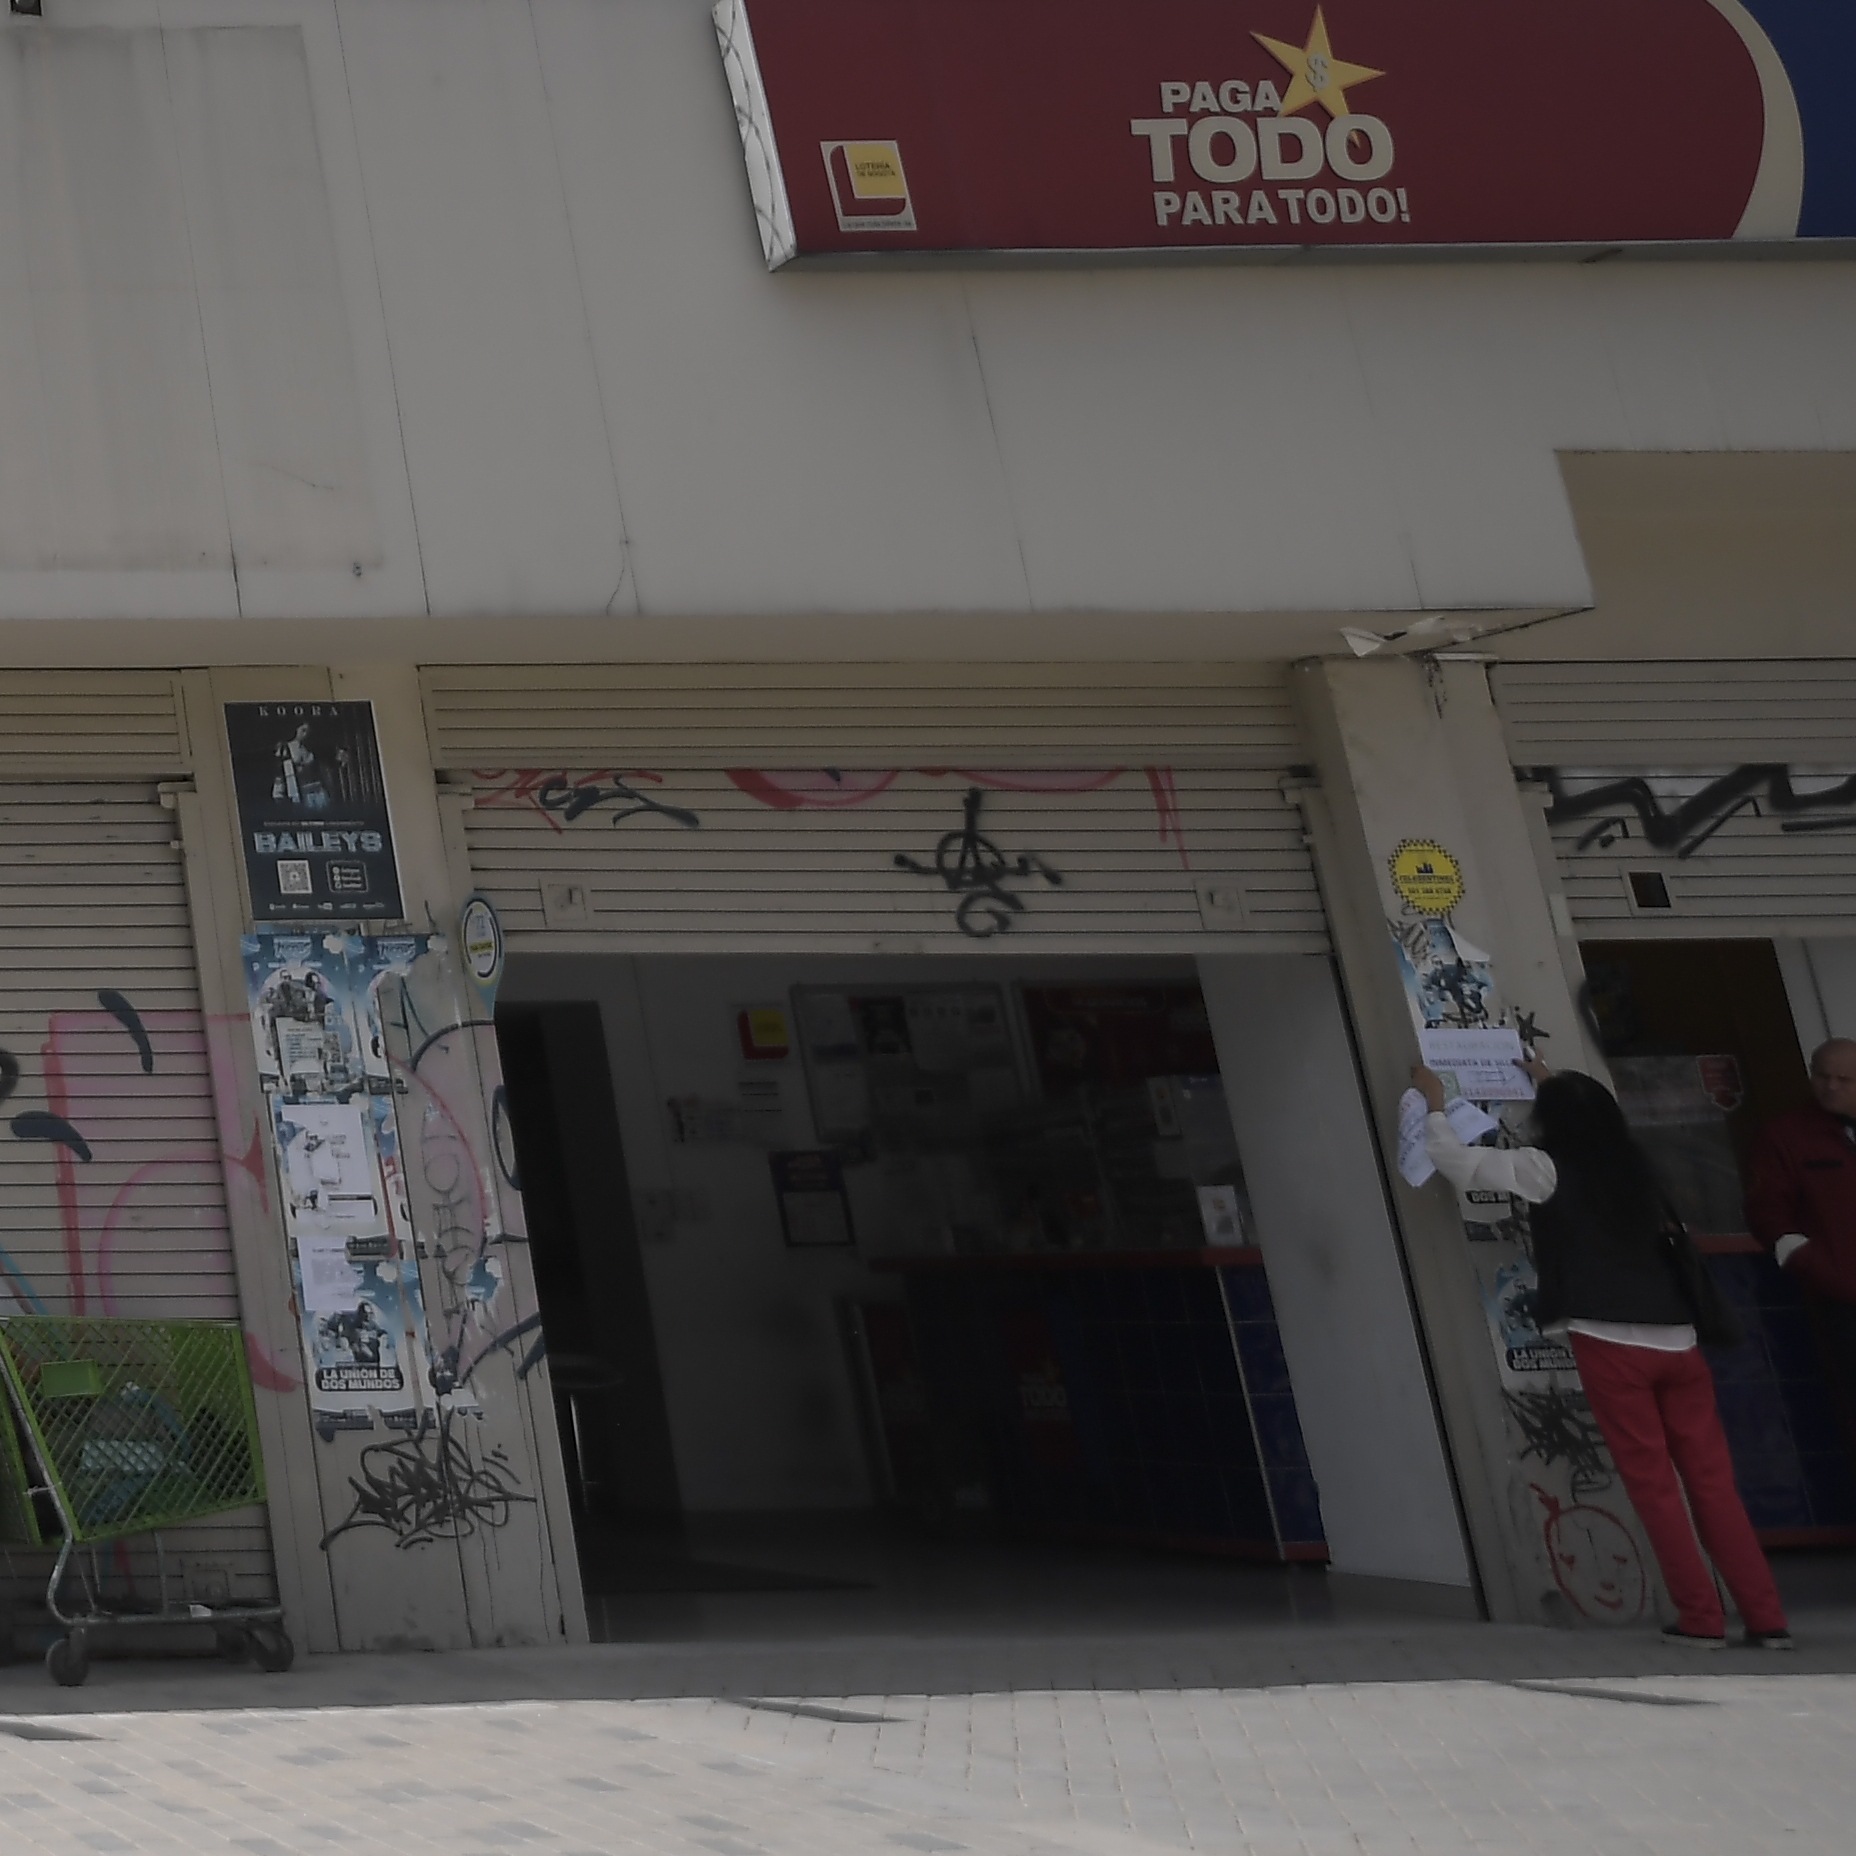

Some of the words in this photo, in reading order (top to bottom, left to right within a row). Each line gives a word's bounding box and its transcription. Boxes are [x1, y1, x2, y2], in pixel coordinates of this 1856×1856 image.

[1160, 79, 1282, 113] PAGA
[1130, 114, 1393, 183] TODO
[1153, 190, 1277, 226] PARA
[1278, 188, 1411, 224] TODO!
[259, 705, 339, 717] KOORA
[253, 831, 383, 853] BAILEYS
[321, 1379, 346, 1390] DOS
[348, 1379, 401, 1390] MUNDOS
[323, 1369, 338, 1379] LA
[380, 1368, 396, 1378] DE
